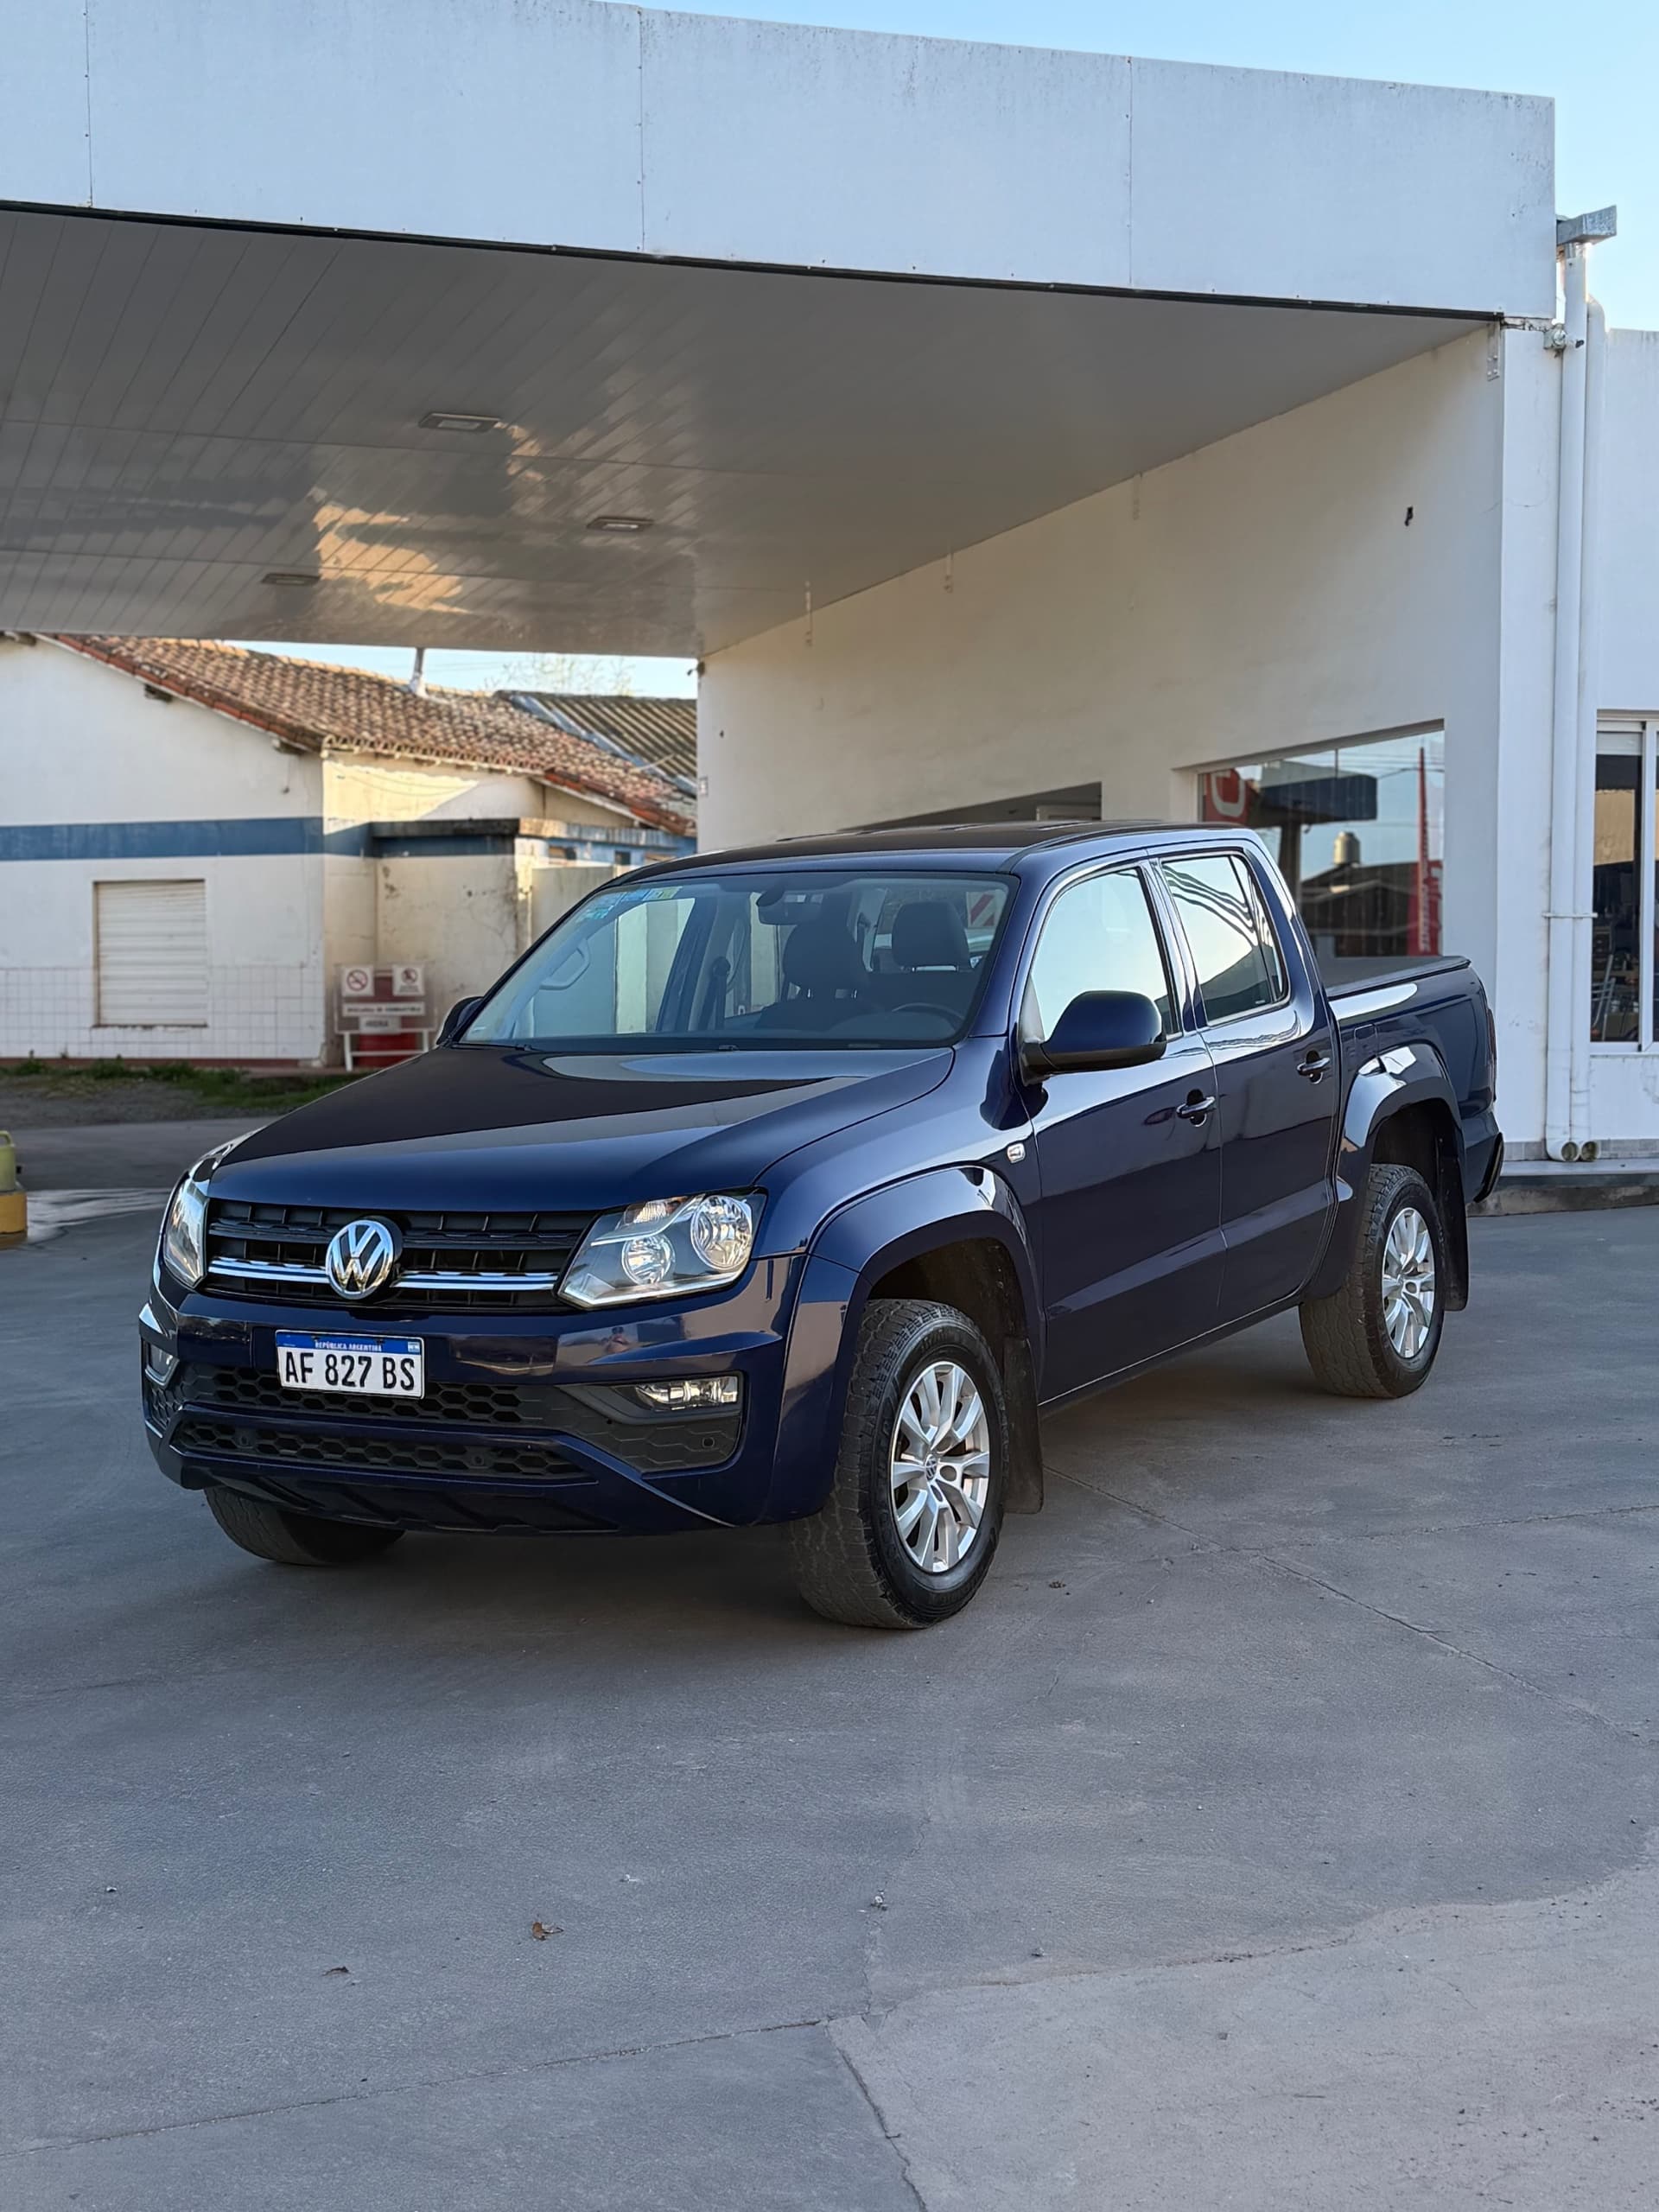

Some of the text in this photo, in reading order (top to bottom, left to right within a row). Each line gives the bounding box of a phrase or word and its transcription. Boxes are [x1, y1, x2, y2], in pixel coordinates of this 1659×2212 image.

[328, 1221, 391, 1296] VW
[286, 1351, 415, 1390] AF 827 BS
